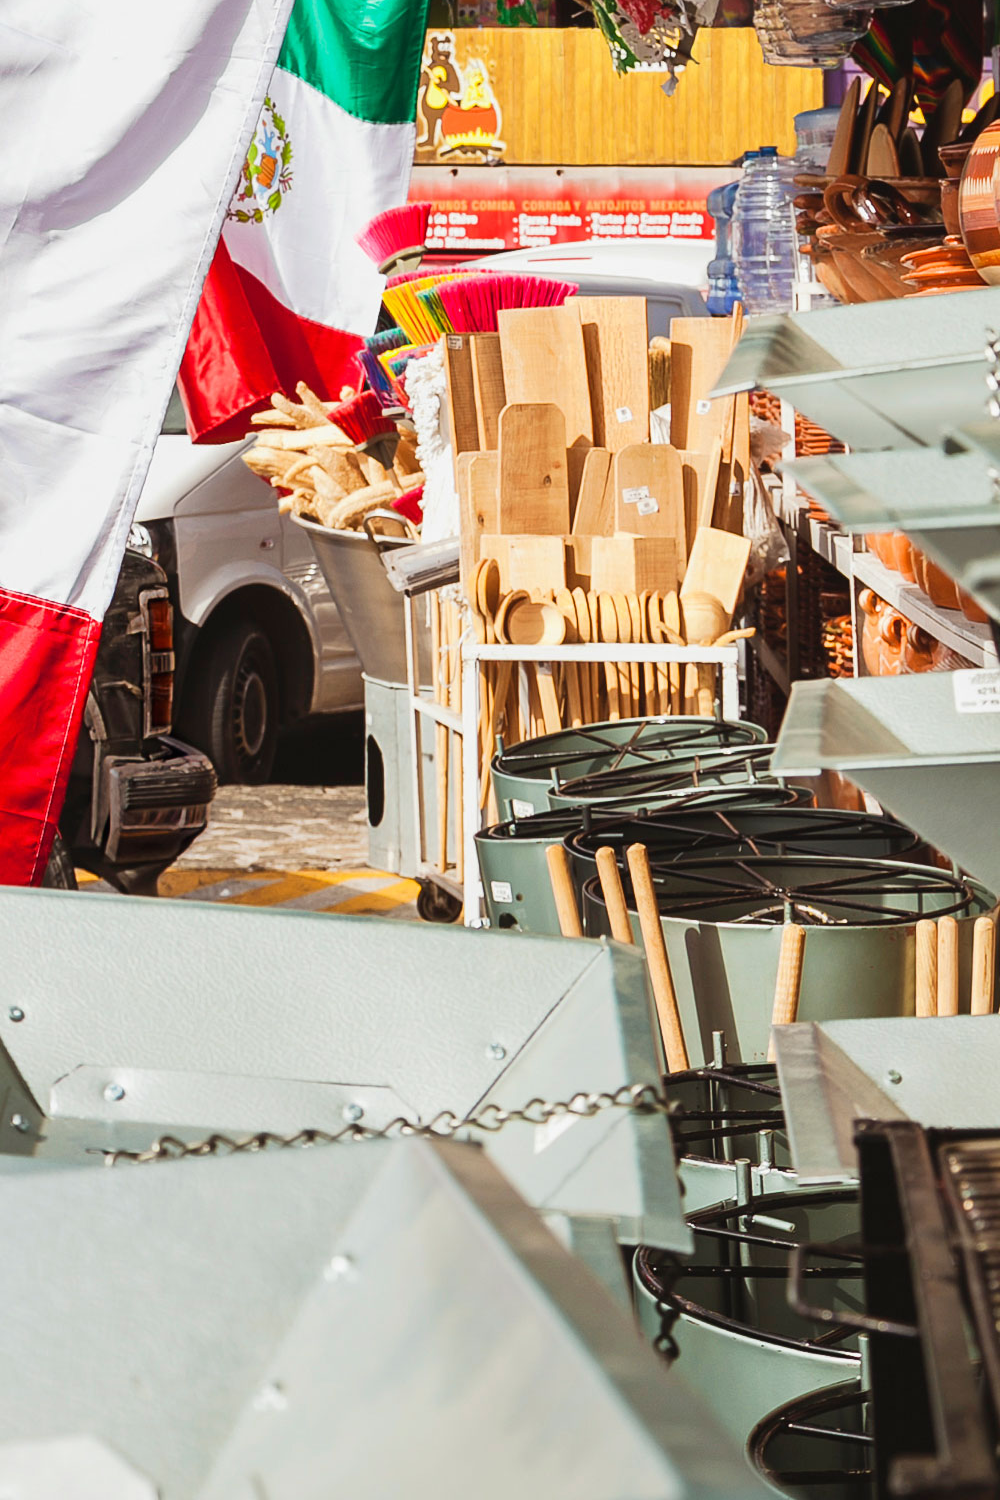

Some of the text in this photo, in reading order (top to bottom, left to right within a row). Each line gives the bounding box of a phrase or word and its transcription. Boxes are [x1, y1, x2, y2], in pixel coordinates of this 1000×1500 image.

[471, 200, 516, 211] COMIDA
[522, 200, 571, 211] CORRIDA
[573, 200, 582, 211] Y
[585, 200, 646, 211] ANTOJITOS
